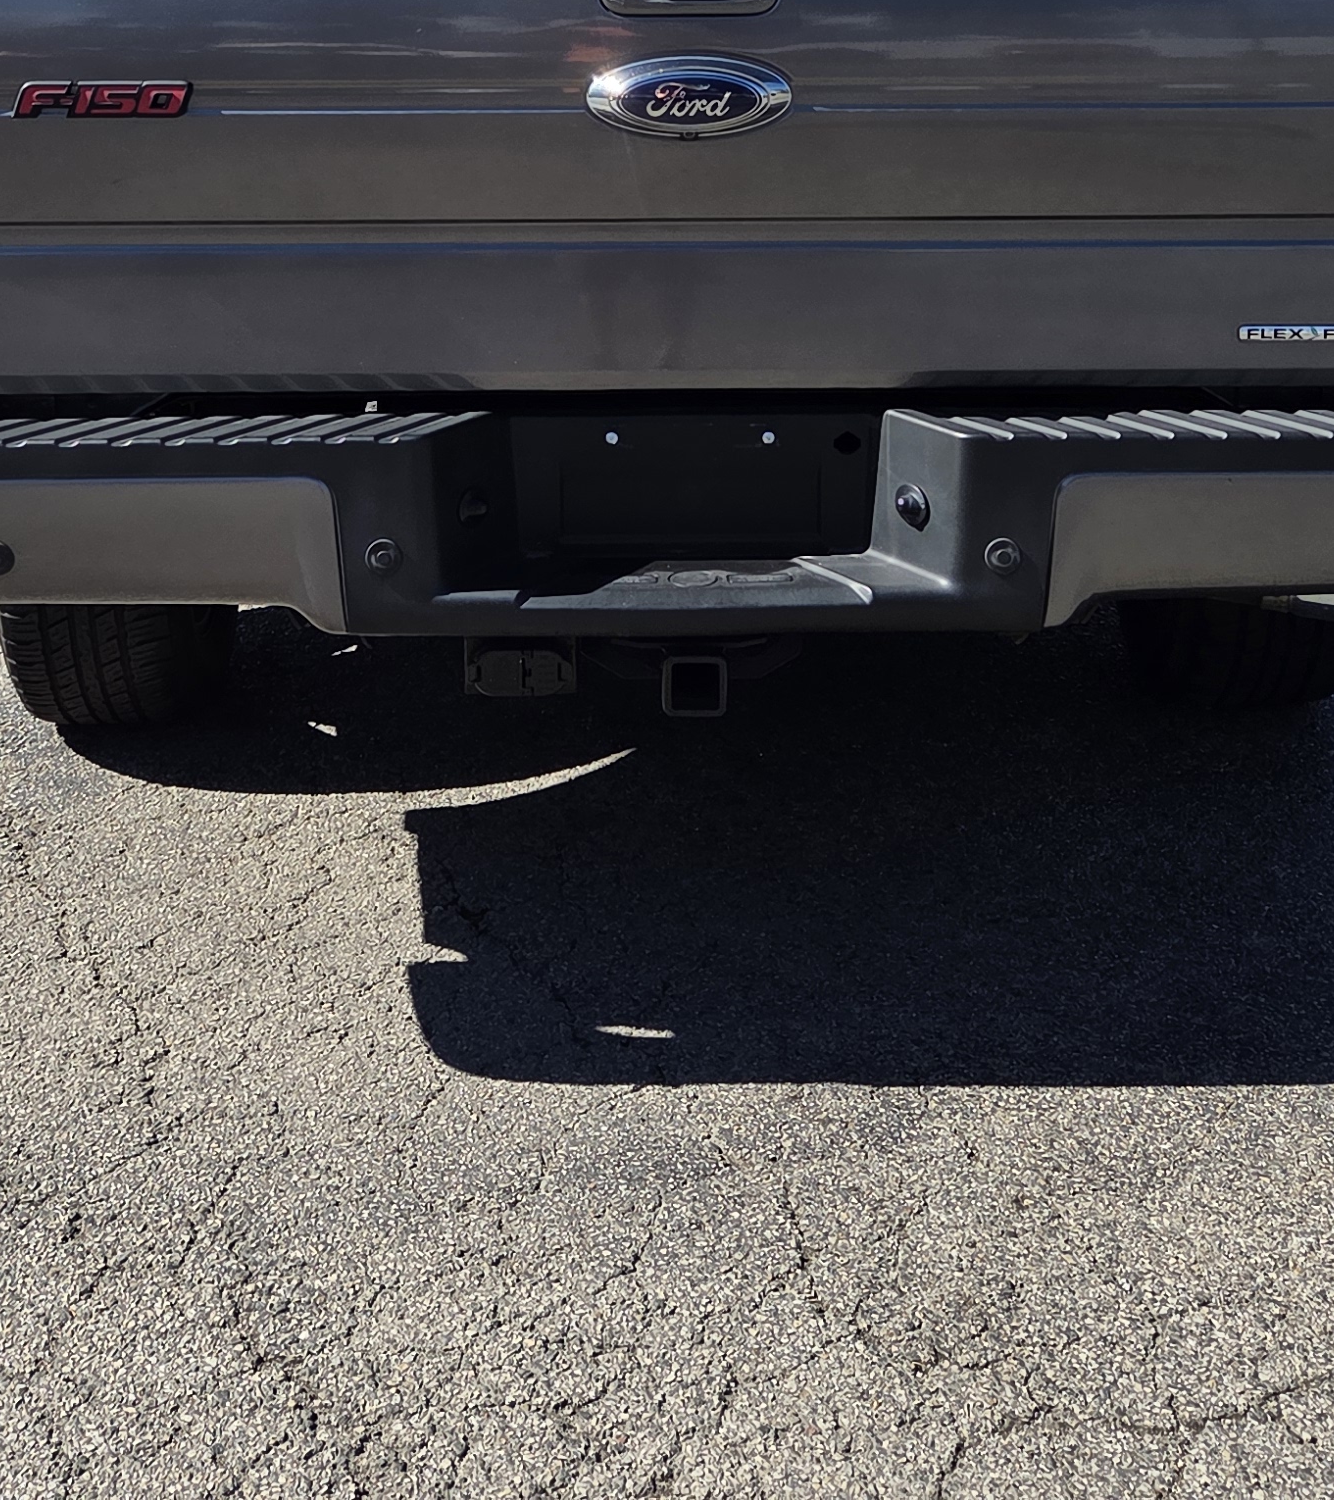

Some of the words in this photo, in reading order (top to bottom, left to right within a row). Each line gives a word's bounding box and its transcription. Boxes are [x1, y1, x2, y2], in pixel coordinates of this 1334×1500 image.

[11, 80, 194, 119] F-150
[646, 82, 732, 117] Ford
[1247, 328, 1304, 340] FLEX
